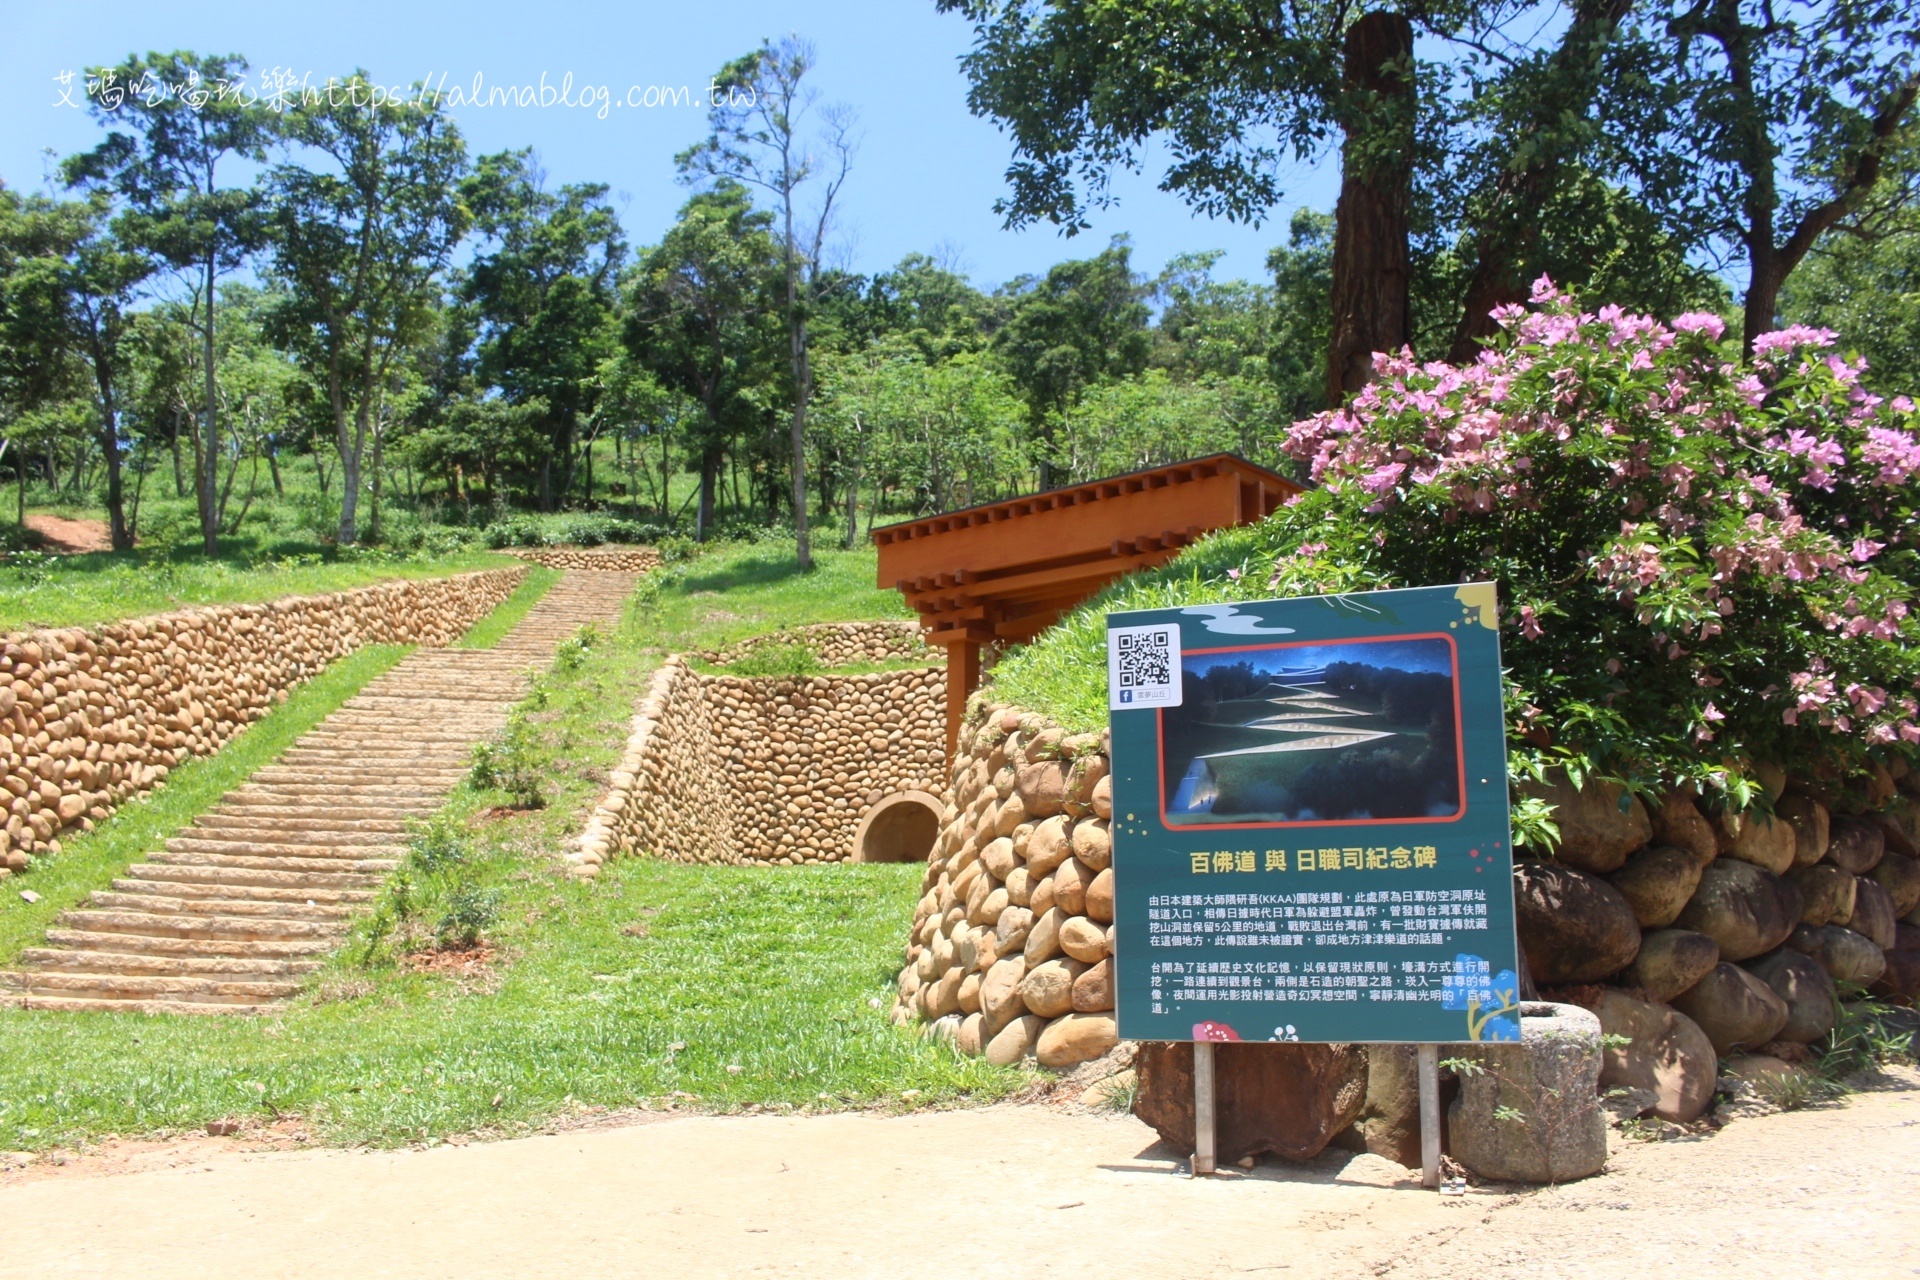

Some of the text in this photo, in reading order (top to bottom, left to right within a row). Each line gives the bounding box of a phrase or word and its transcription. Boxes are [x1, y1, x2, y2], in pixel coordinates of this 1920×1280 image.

[1189, 846, 1437, 874] 百佛道 與 日職司紀念碑
